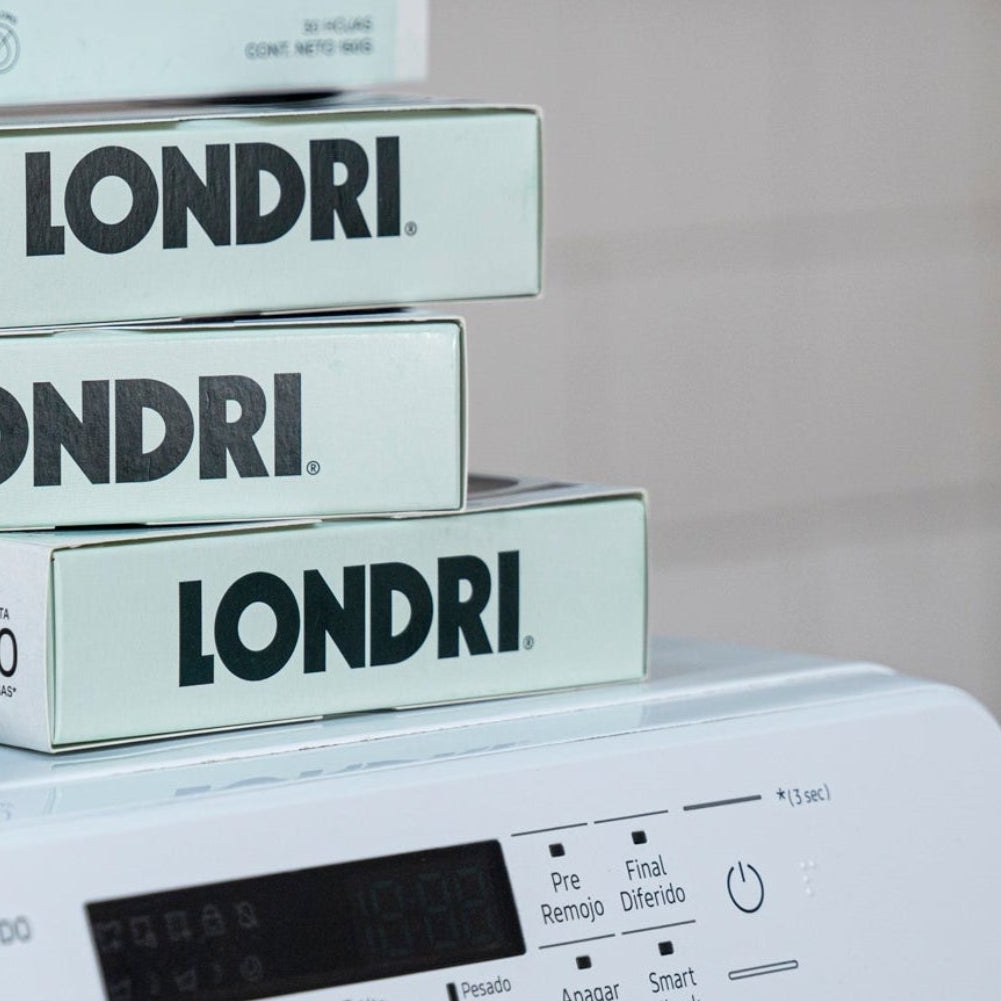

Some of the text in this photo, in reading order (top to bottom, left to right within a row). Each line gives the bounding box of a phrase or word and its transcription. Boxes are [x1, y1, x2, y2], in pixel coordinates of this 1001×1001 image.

[625, 854, 667, 882] Final
[551, 871, 582, 893] Pre
[541, 896, 605, 925] Remojo
[620, 882, 686, 912] Diferido
[461, 977, 512, 999] Pesado
[648, 966, 698, 993] Smart
